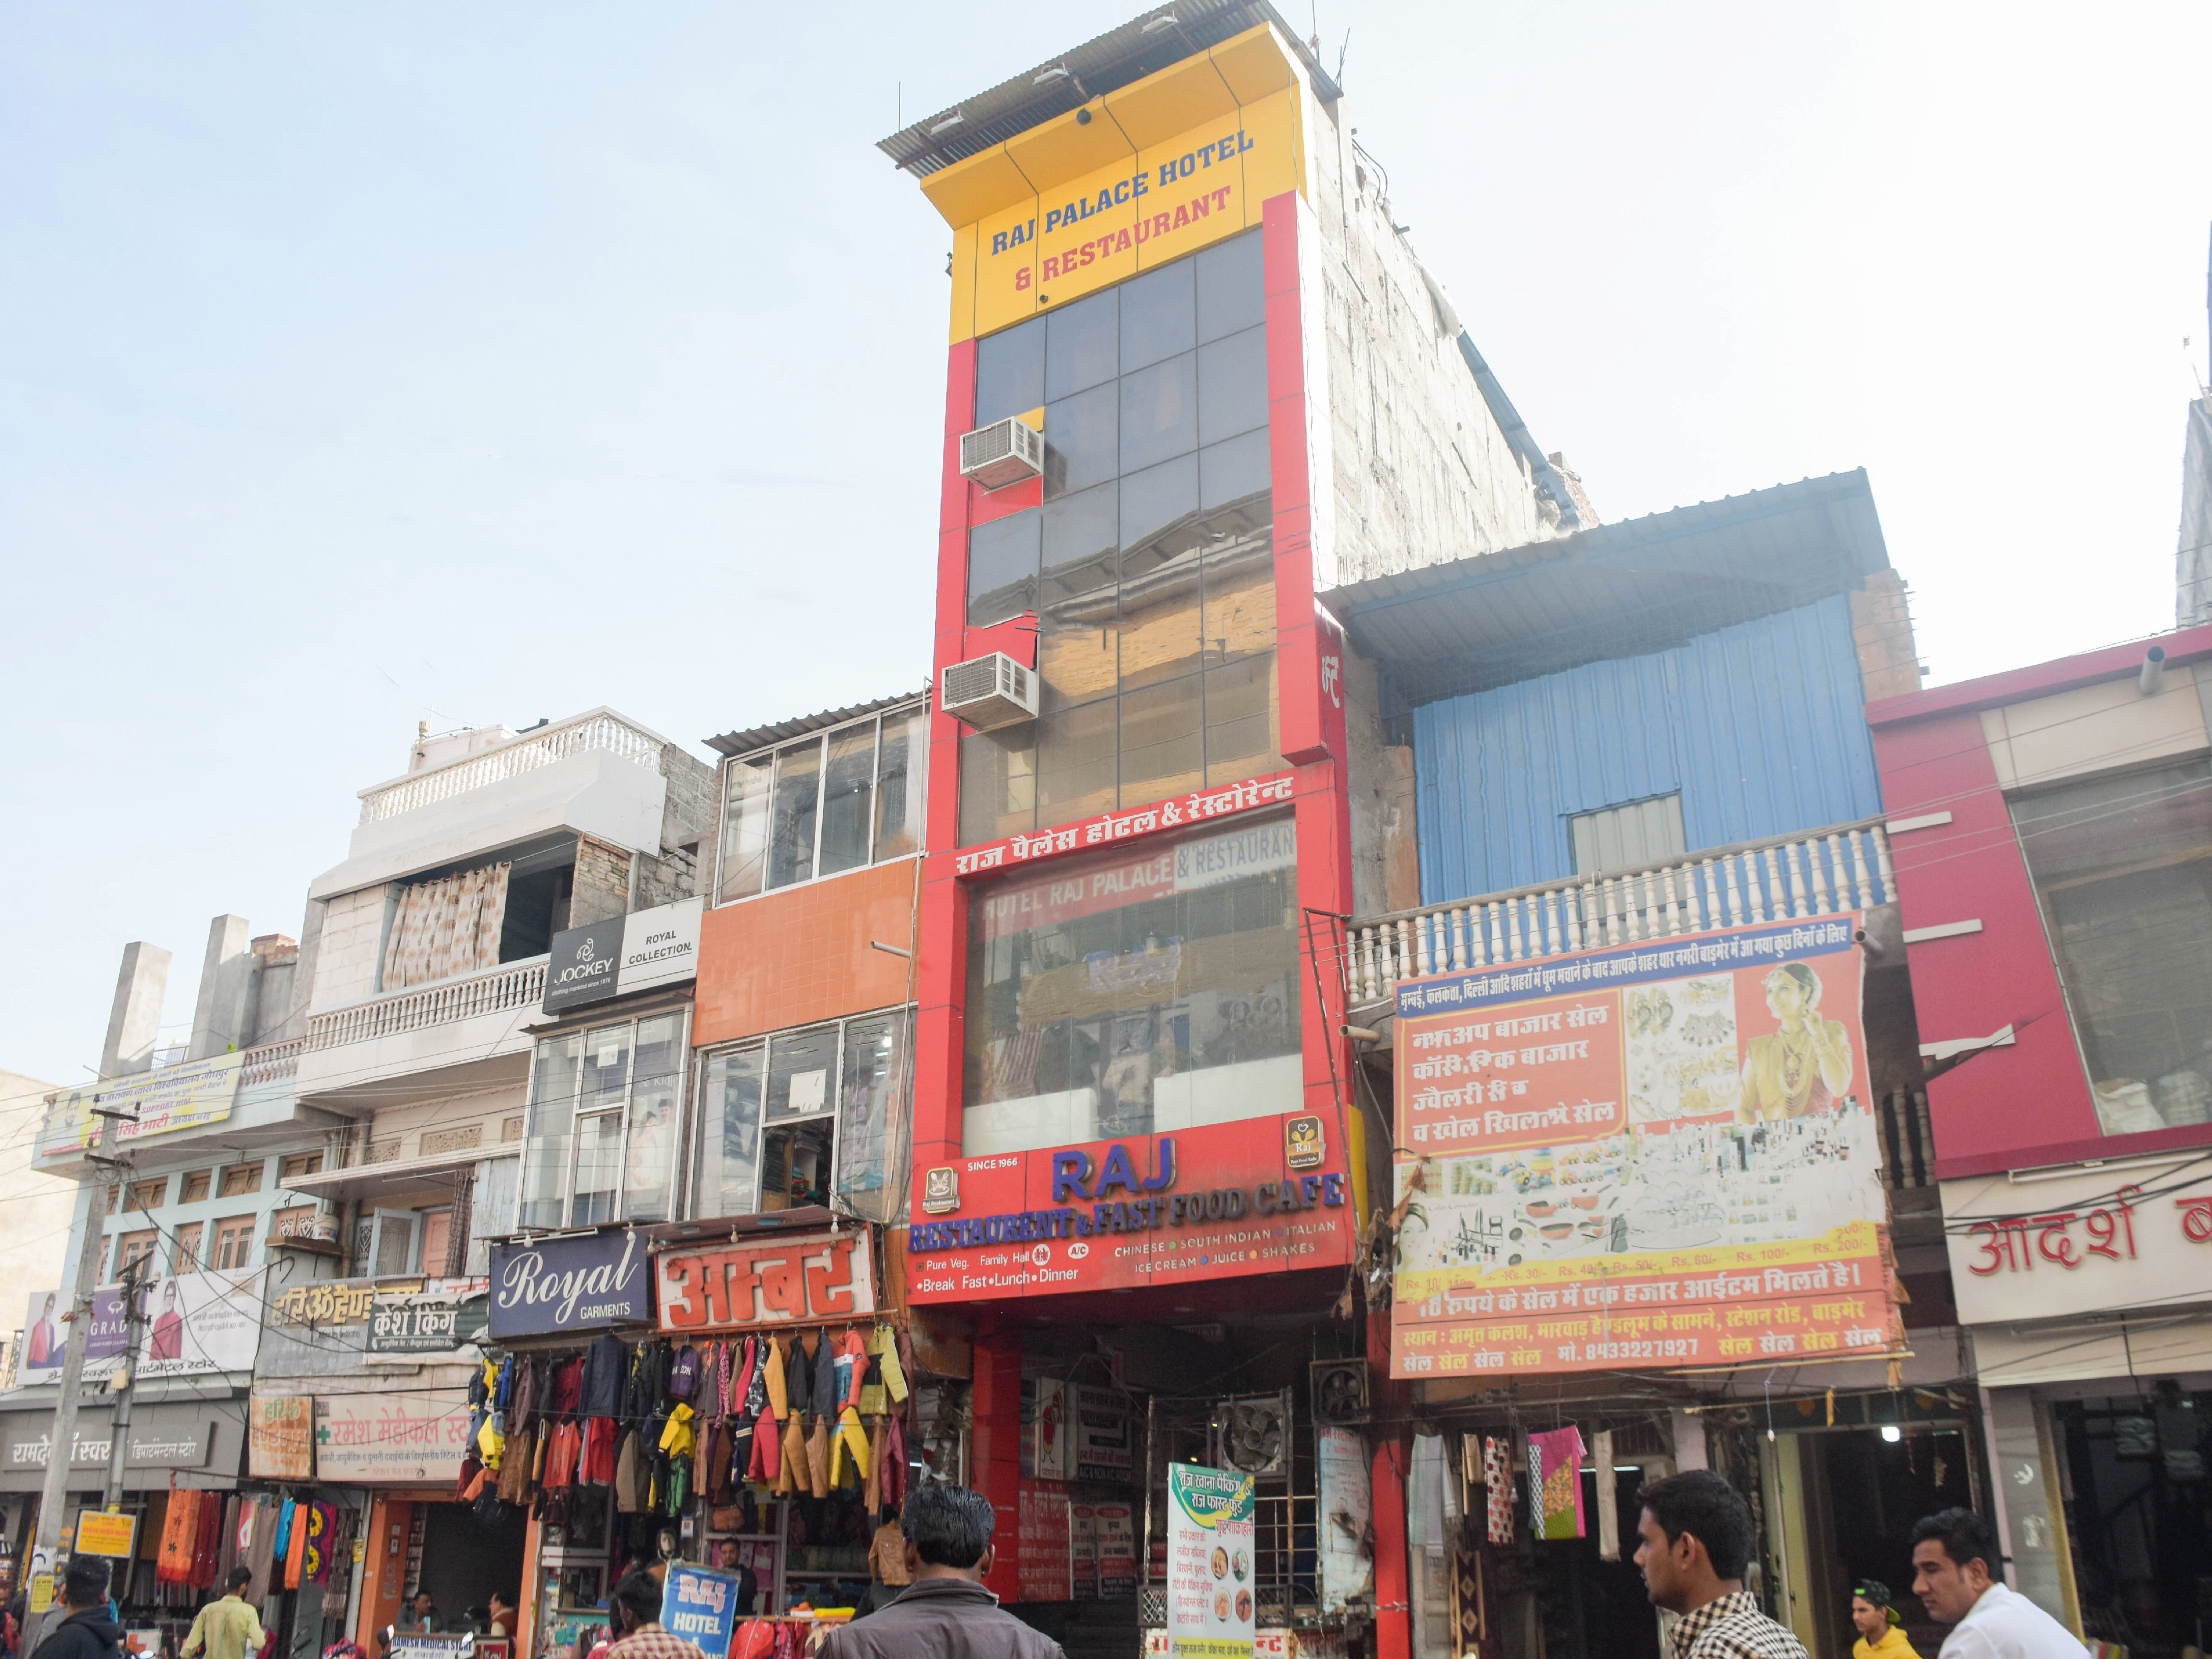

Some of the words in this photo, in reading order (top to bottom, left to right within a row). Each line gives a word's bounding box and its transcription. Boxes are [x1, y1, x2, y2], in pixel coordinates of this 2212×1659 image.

[992, 219, 1035, 256] RAJ
[1045, 172, 1148, 234] PALACE
[1159, 130, 1254, 187] HOTEL
[1015, 267, 1031, 291] &
[1042, 185, 1231, 282] RESTAURANT
[956, 845, 1005, 875] राज
[1011, 828, 1078, 860] पैलेस
[1086, 810, 1158, 844] होटल
[1161, 802, 1182, 827] &
[1186, 776, 1293, 819] रेस्टोरेन्ट
[1050, 883, 1083, 907] RAJ
[1093, 857, 1171, 896] PALACE
[1196, 828, 1296, 874] RESTAURAN
[646, 930, 676, 944] ROYAL
[629, 942, 692, 964] COLLECTION
[1464, 976, 1488, 999] दिल्ली
[1490, 973, 1509, 995] आदि
[1511, 968, 1532, 990] शहरों
[1542, 969, 1555, 992] धूम
[1583, 960, 1590, 979] के
[1593, 959, 1608, 978] बाद
[1610, 952, 1637, 976] आपके
[1638, 954, 1659, 971] शहर
[1675, 943, 1699, 965] नगरी
[1731, 936, 1739, 957] में
[1741, 940, 1754, 956] आ
[1755, 938, 1773, 954] गया
[1793, 925, 1814, 947] दिनों
[1816, 925, 1826, 944] के
[1827, 923, 1848, 943] लिए
[555, 958, 613, 985] JOCKEY
[552, 987, 568, 995] clothing
[569, 984, 587, 992] mankind
[1494, 1013, 1561, 1037] बाजार
[1566, 1004, 1609, 1027] सेल
[1520, 1040, 1589, 1065] बाजार
[142, 1102, 173, 1114] SUPPORT
[143, 1113, 169, 1130] भाटी
[1413, 1124, 1429, 1142] व
[1433, 1116, 1480, 1139] खेल
[1573, 1099, 1616, 1123] सेल
[1297, 1142, 1311, 1152] Raj
[968, 1160, 995, 1171] SINCE
[998, 1158, 1017, 1168] 1966
[1053, 1138, 1176, 1202] RAJ
[909, 1208, 1073, 1252] RESTAURENT
[1076, 1215, 1090, 1235] &
[1093, 1198, 1164, 1234] FAST
[1170, 1189, 1247, 1226] FOOD
[1255, 1173, 1344, 1215] CAFE
[1115, 1242, 1165, 1257] CHINESE
[1180, 1236, 1220, 1249] SOUTH
[1225, 1229, 1270, 1243] INDIAN
[1285, 1221, 1336, 1237] ITALIAN
[1968, 1184, 2142, 1276] आदर्श
[927, 1260, 946, 1270] Pure
[950, 1259, 969, 1269] Veg.
[980, 1254, 1008, 1266] Family
[1013, 1251, 1029, 1263] Hall
[1071, 1247, 1086, 1255] A/C
[1135, 1263, 1151, 1273] ICE
[1155, 1257, 1196, 1271] CREAM
[1212, 1251, 1245, 1264] JUICE
[1262, 1243, 1315, 1258] SHAKES
[1526, 1268, 1546, 1280] 30/-
[1559, 1266, 1576, 1276] Rs.
[1613, 1263, 1631, 1272] Rs.
[1672, 1257, 1690, 1267] Rs.
[1695, 1254, 1717, 1265] 60/-
[1737, 1251, 1756, 1262] Rs.
[1762, 1248, 1789, 1260] 100/-
[1813, 1244, 1830, 1254] Rs.
[1838, 1239, 1867, 1251] 200/-
[498, 1239, 638, 1324] Royal
[923, 1279, 954, 1292] Break
[962, 1276, 986, 1289] Fast
[995, 1270, 1030, 1286] Lunch
[1039, 1268, 1078, 1282] Dinner
[1446, 1288, 1493, 1315] रुपये
[1498, 1289, 1518, 1311] के
[1522, 1288, 1558, 1309] सेल
[1564, 1283, 1580, 1306] में
[1583, 1285, 1619, 1304] एक
[1624, 1282, 1678, 1304] हजार
[1684, 1273, 1760, 1299] आईटम
[1764, 1264, 1830, 1293] मिलते
[581, 1302, 630, 1319] GARMENTS
[1450, 1328, 1484, 1349] अमृत
[1538, 1320, 1588, 1341] मारवाड़
[1653, 1311, 1667, 1330] के
[1726, 1306, 1771, 1327] स्टेशन
[1812, 1297, 1865, 1325] बाड़मेर
[90, 1319, 127, 1336] GRAD
[1404, 1352, 1433, 1372] सेल
[1439, 1351, 1468, 1370] सेल
[1474, 1348, 1504, 1367] सेल
[1510, 1346, 1542, 1365] सेल
[1558, 1341, 1582, 1361] मो.
[1586, 1338, 1698, 1360] 8433227927
[1719, 1335, 1753, 1354] सेल
[1759, 1332, 1794, 1354] सेल
[1801, 1329, 1837, 1349] सेल
[1844, 1325, 1882, 1348] सेल
[332, 1408, 371, 1445] रमेश
[376, 1405, 440, 1445] मेडीकल
[1179, 1472, 1193, 1487] राज
[1195, 1474, 1215, 1490] खाना
[1217, 1472, 1241, 1494] पैकिंग
[1245, 1484, 1251, 1495] &
[1192, 1493, 1205, 1507] राज
[1207, 1495, 1227, 1510] फास्ट
[1229, 1498, 1243, 1517] फुड
[678, 1574, 726, 1613] RAJ
[673, 1612, 721, 1634] HOTEL
[392, 1636, 419, 1647] RAMESH
[420, 1638, 448, 1650] MEDICAL
